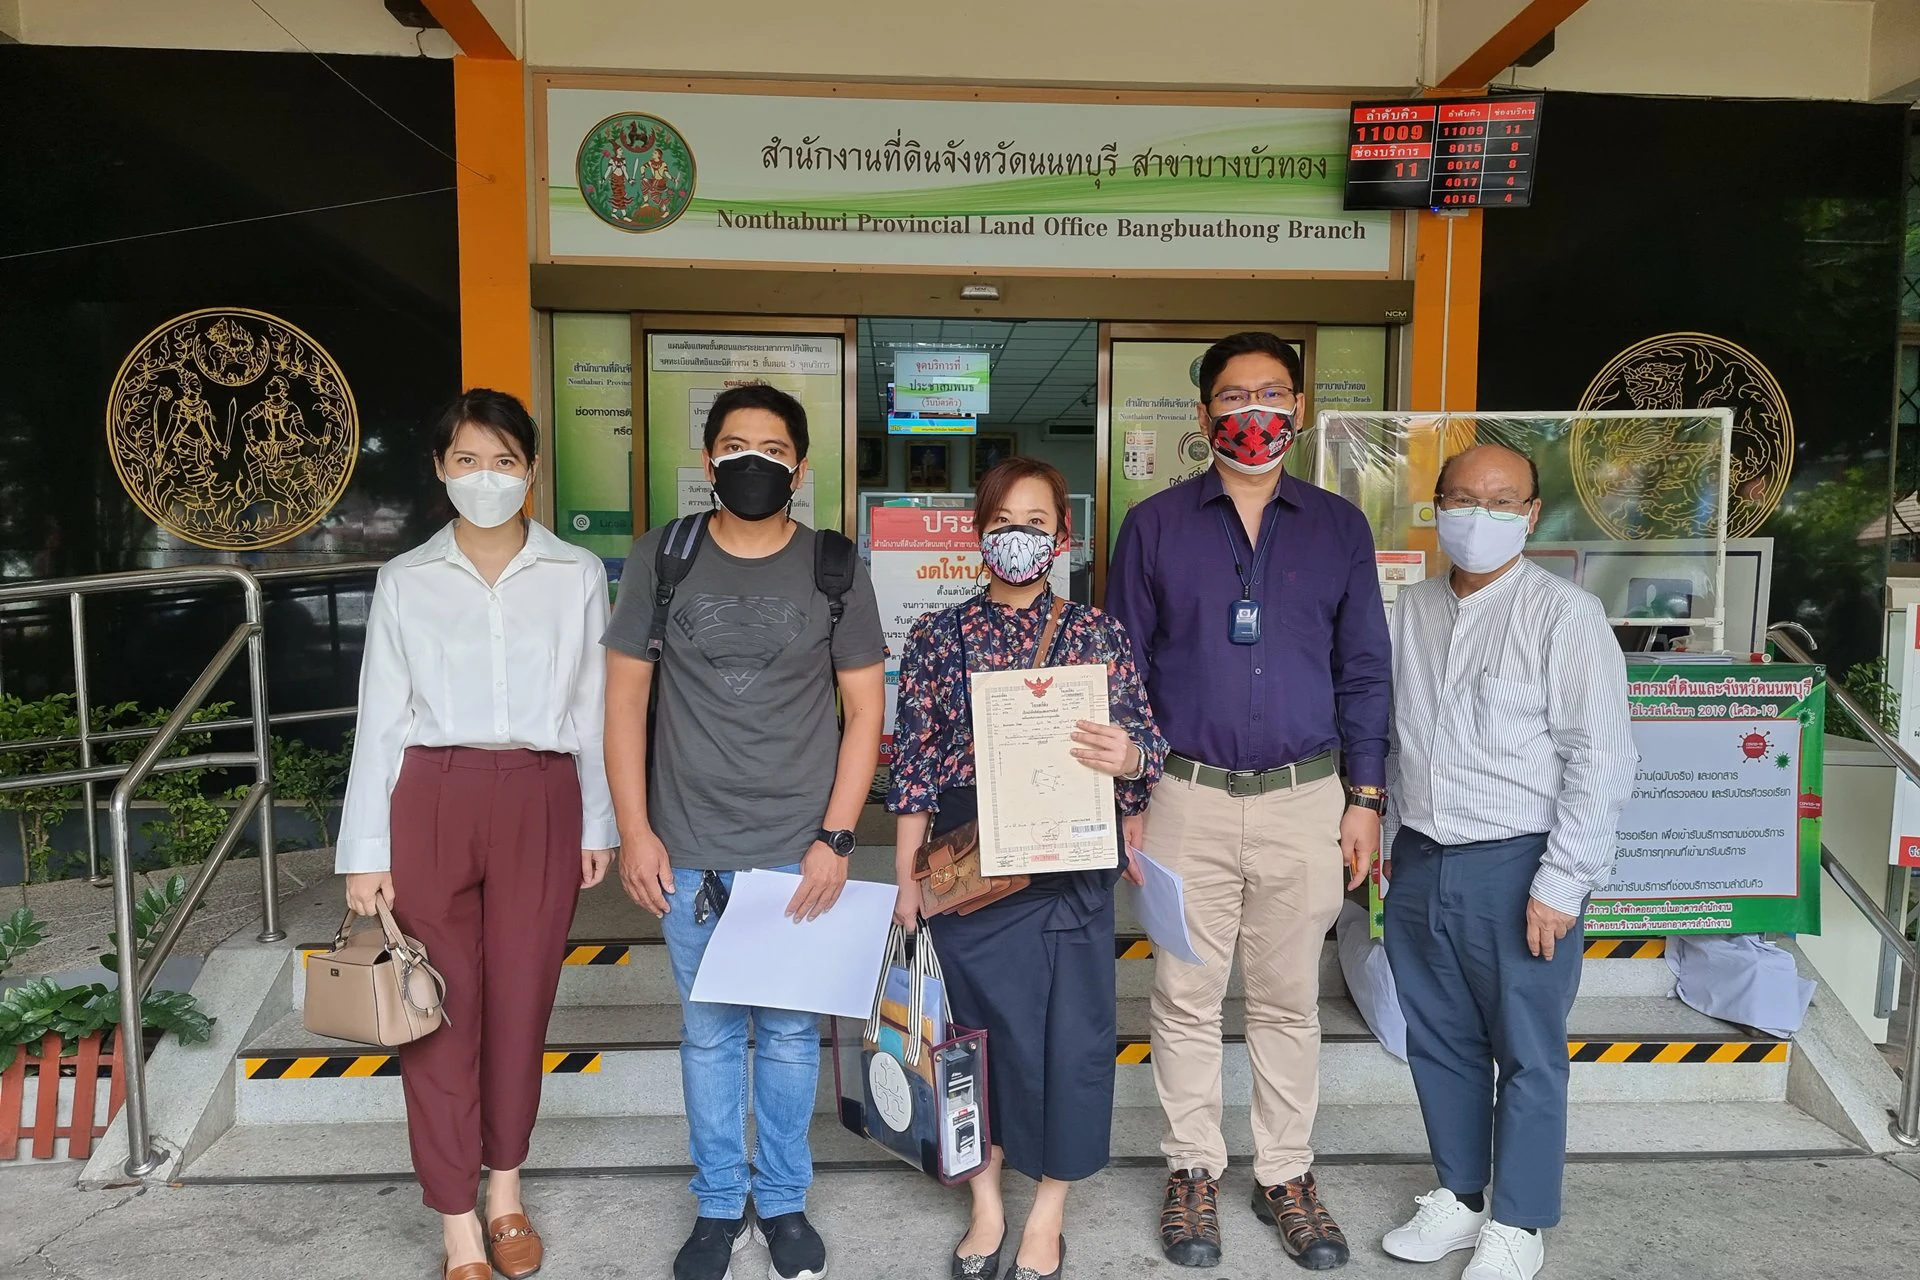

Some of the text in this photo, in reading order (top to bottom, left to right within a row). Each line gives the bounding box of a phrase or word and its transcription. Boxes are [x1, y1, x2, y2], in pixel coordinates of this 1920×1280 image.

[1366, 107, 1418, 121] ลำดับคิว
[1356, 125, 1423, 142] 11009
[1443, 124, 1521, 136] 11009 11
[1354, 146, 1420, 158] ช่องบริการ
[1448, 142, 1519, 153] 8015 8
[761, 129, 1327, 189] สำนักงานที่ดินจังหวัดนนทบุรี สาขาบางบัวทอง
[1447, 159, 1516, 171] 8014 8
[1395, 162, 1418, 177] 11
[1445, 176, 1514, 187] 4017 4
[1443, 193, 1512, 204] 4016 4
[716, 209, 1366, 243] Nonthaburi Provincial Land Office Bangbuathong Branch
[1699, 706, 1726, 717] 2019
[1729, 704, 1779, 718] (โควิด-19)
[1697, 770, 1739, 782] และเอกสาร
